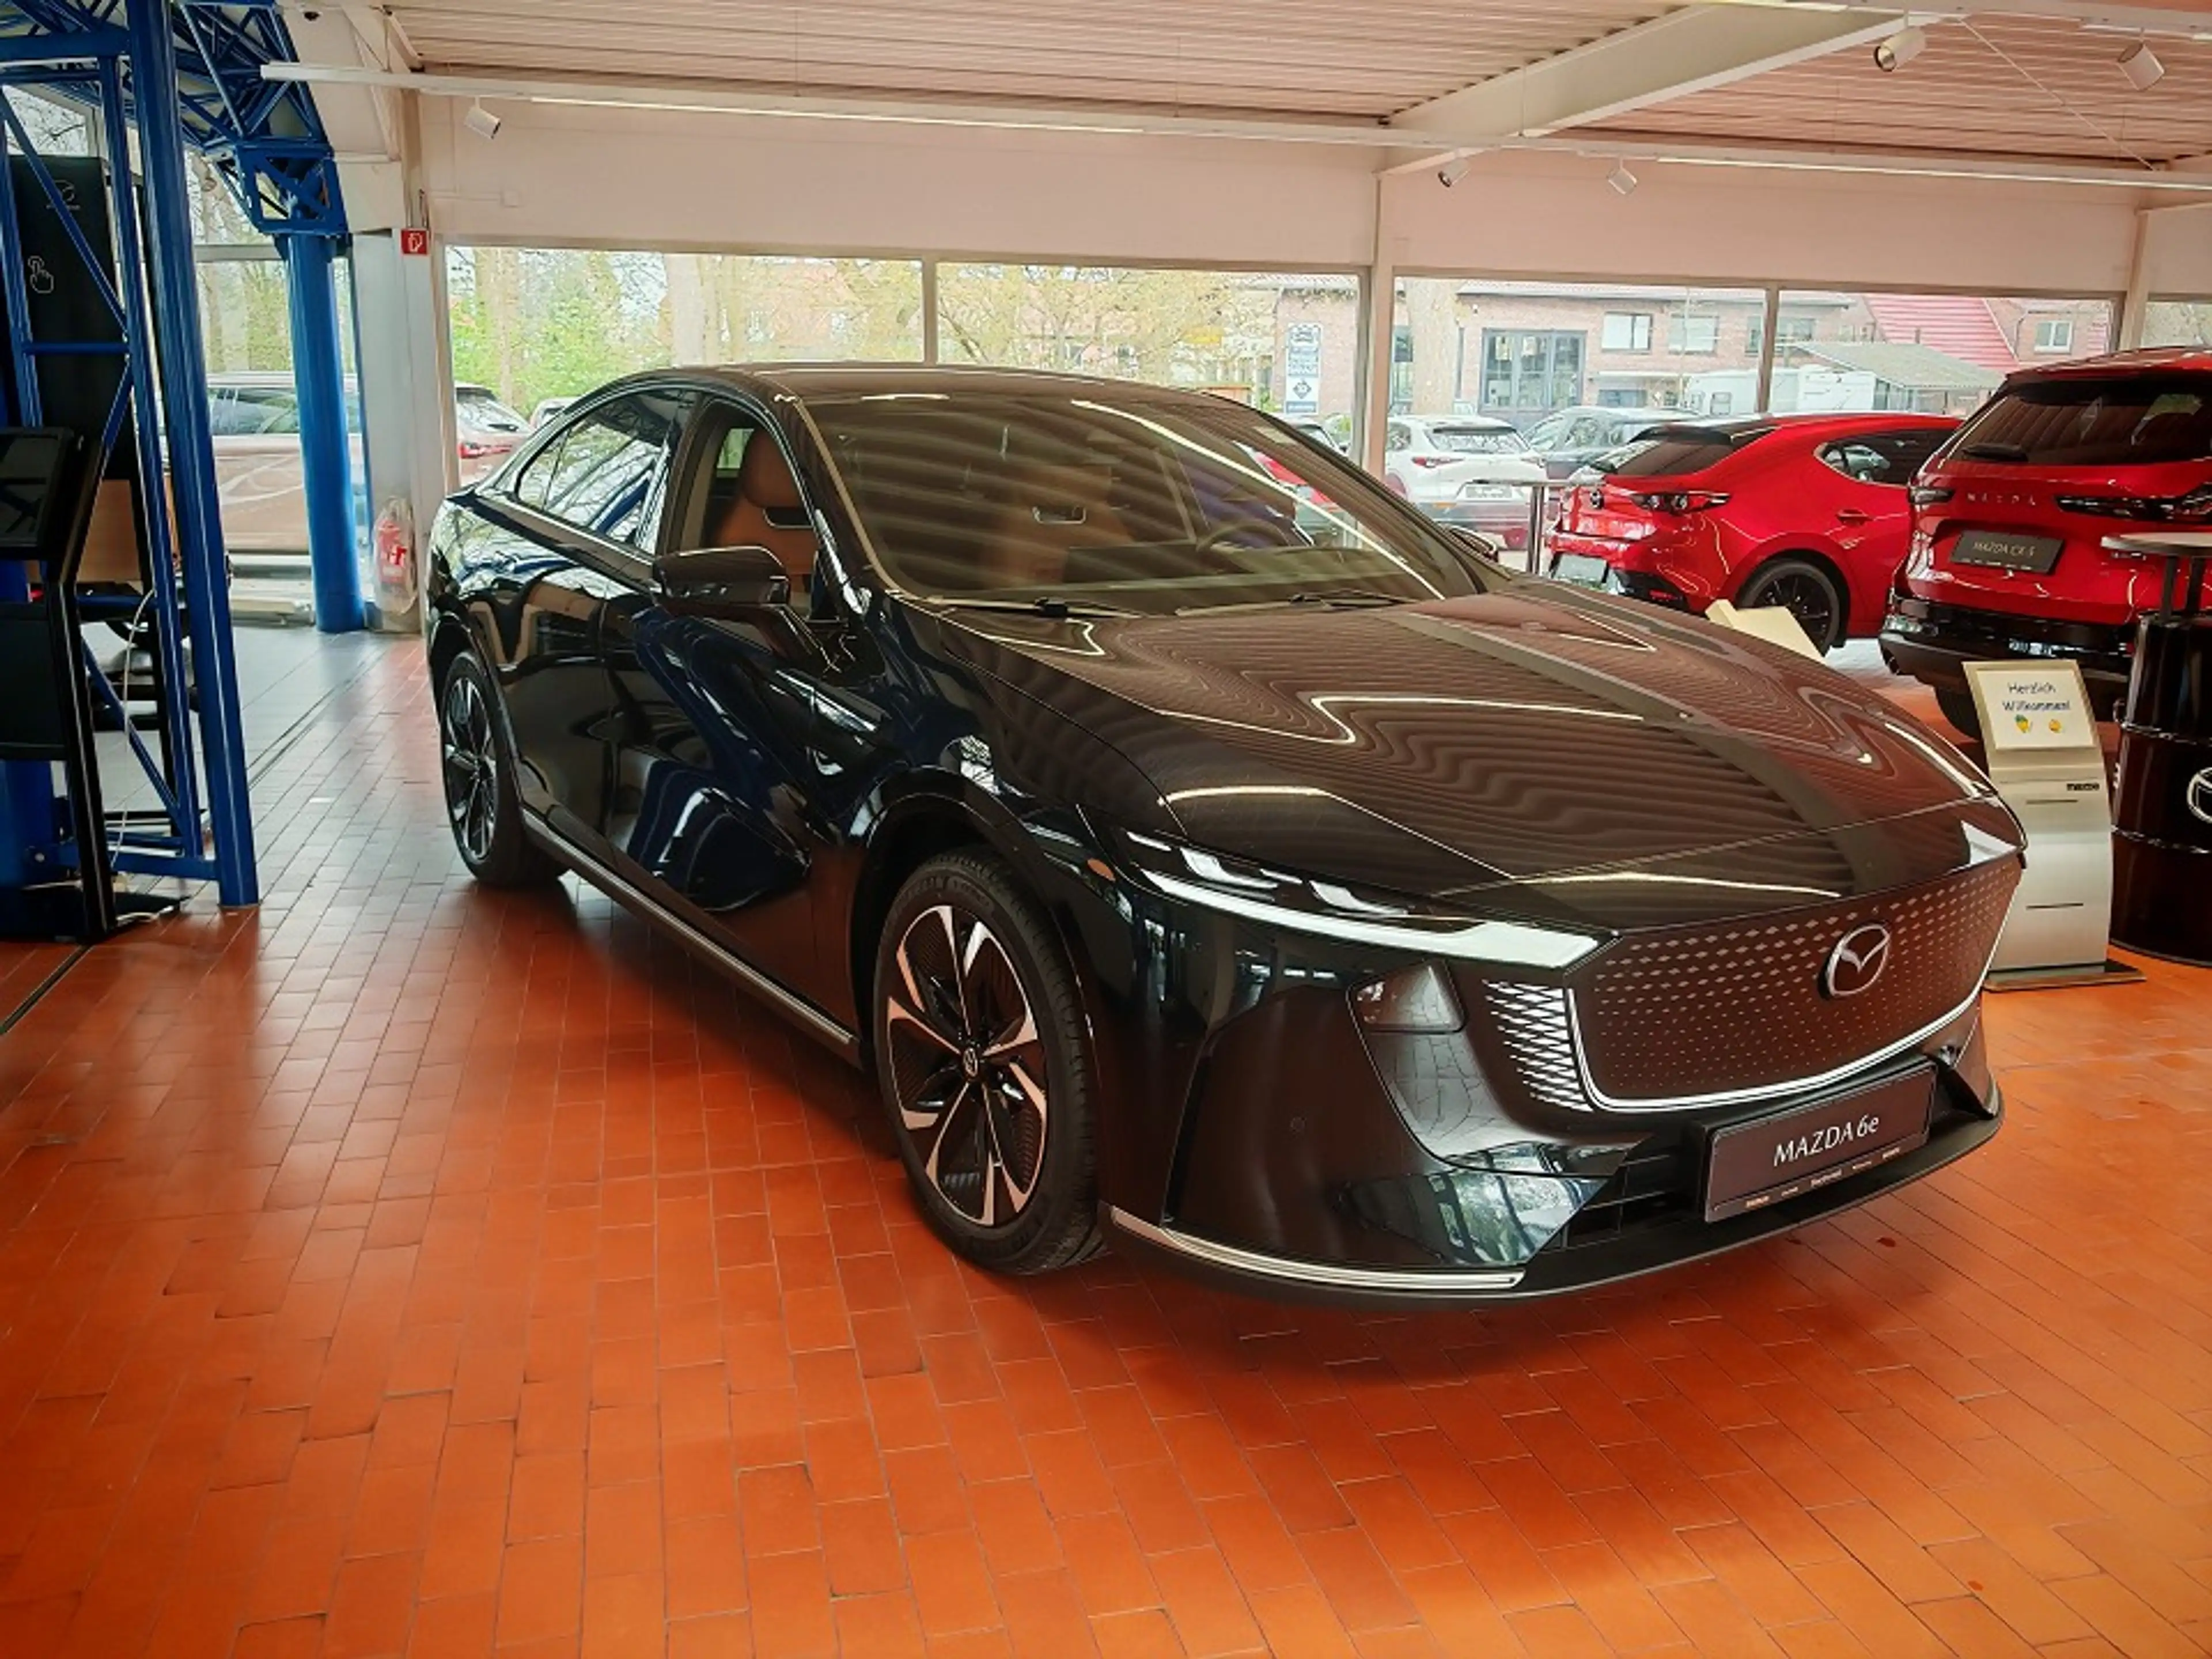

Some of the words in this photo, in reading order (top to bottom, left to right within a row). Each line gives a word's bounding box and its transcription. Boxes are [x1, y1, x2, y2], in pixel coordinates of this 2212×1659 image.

[2008, 681, 2056, 694] Herzlich
[1774, 1122, 1854, 1167] MAZDA
[1857, 1113, 1879, 1137] 6e
